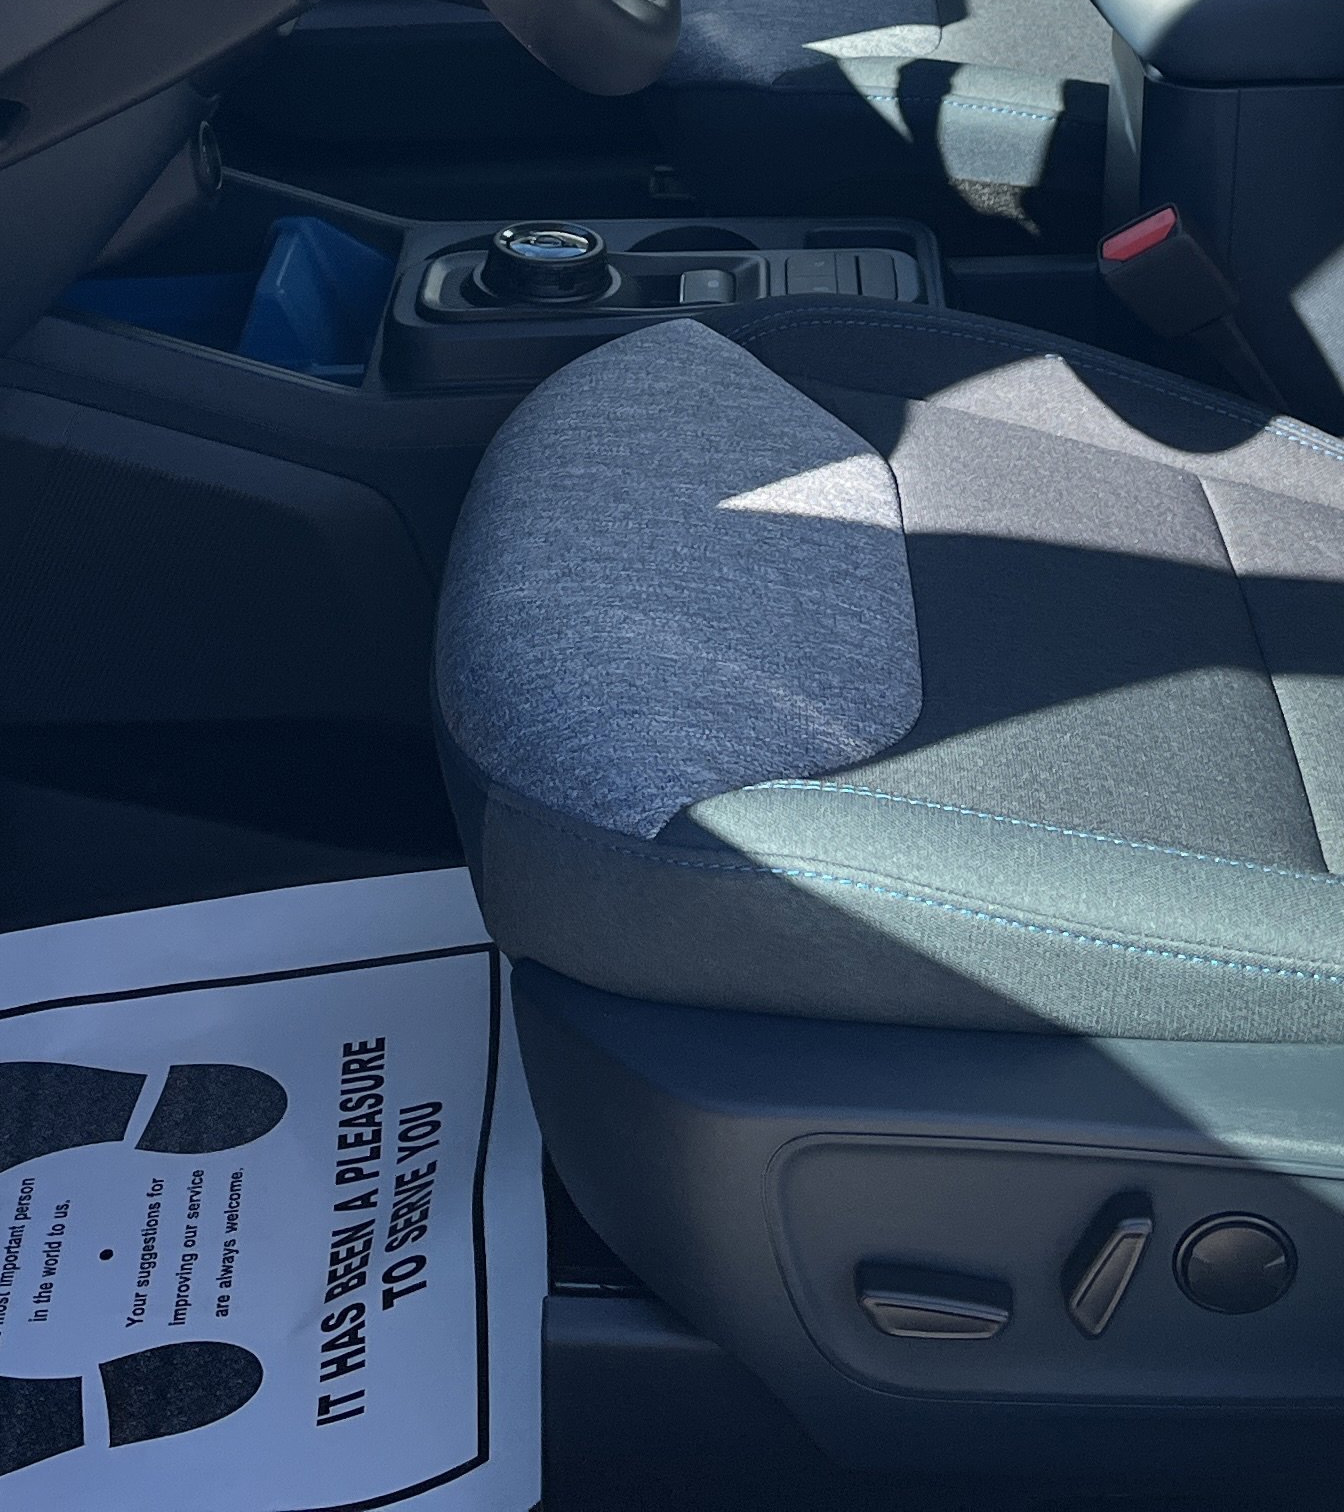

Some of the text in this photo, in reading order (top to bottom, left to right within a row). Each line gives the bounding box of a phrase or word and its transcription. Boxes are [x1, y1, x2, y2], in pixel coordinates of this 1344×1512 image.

[13, 1176, 36, 1221] person
[27, 1198, 71, 1323] in the world to us.
[124, 1176, 166, 1329] Your suggestions for
[167, 1168, 205, 1327] improving our service
[215, 1167, 244, 1318] are always welcome.
[315, 1035, 387, 1427] IT HAS BEEN A PLEASURE
[381, 1100, 444, 1312] TO SERVE YOU
